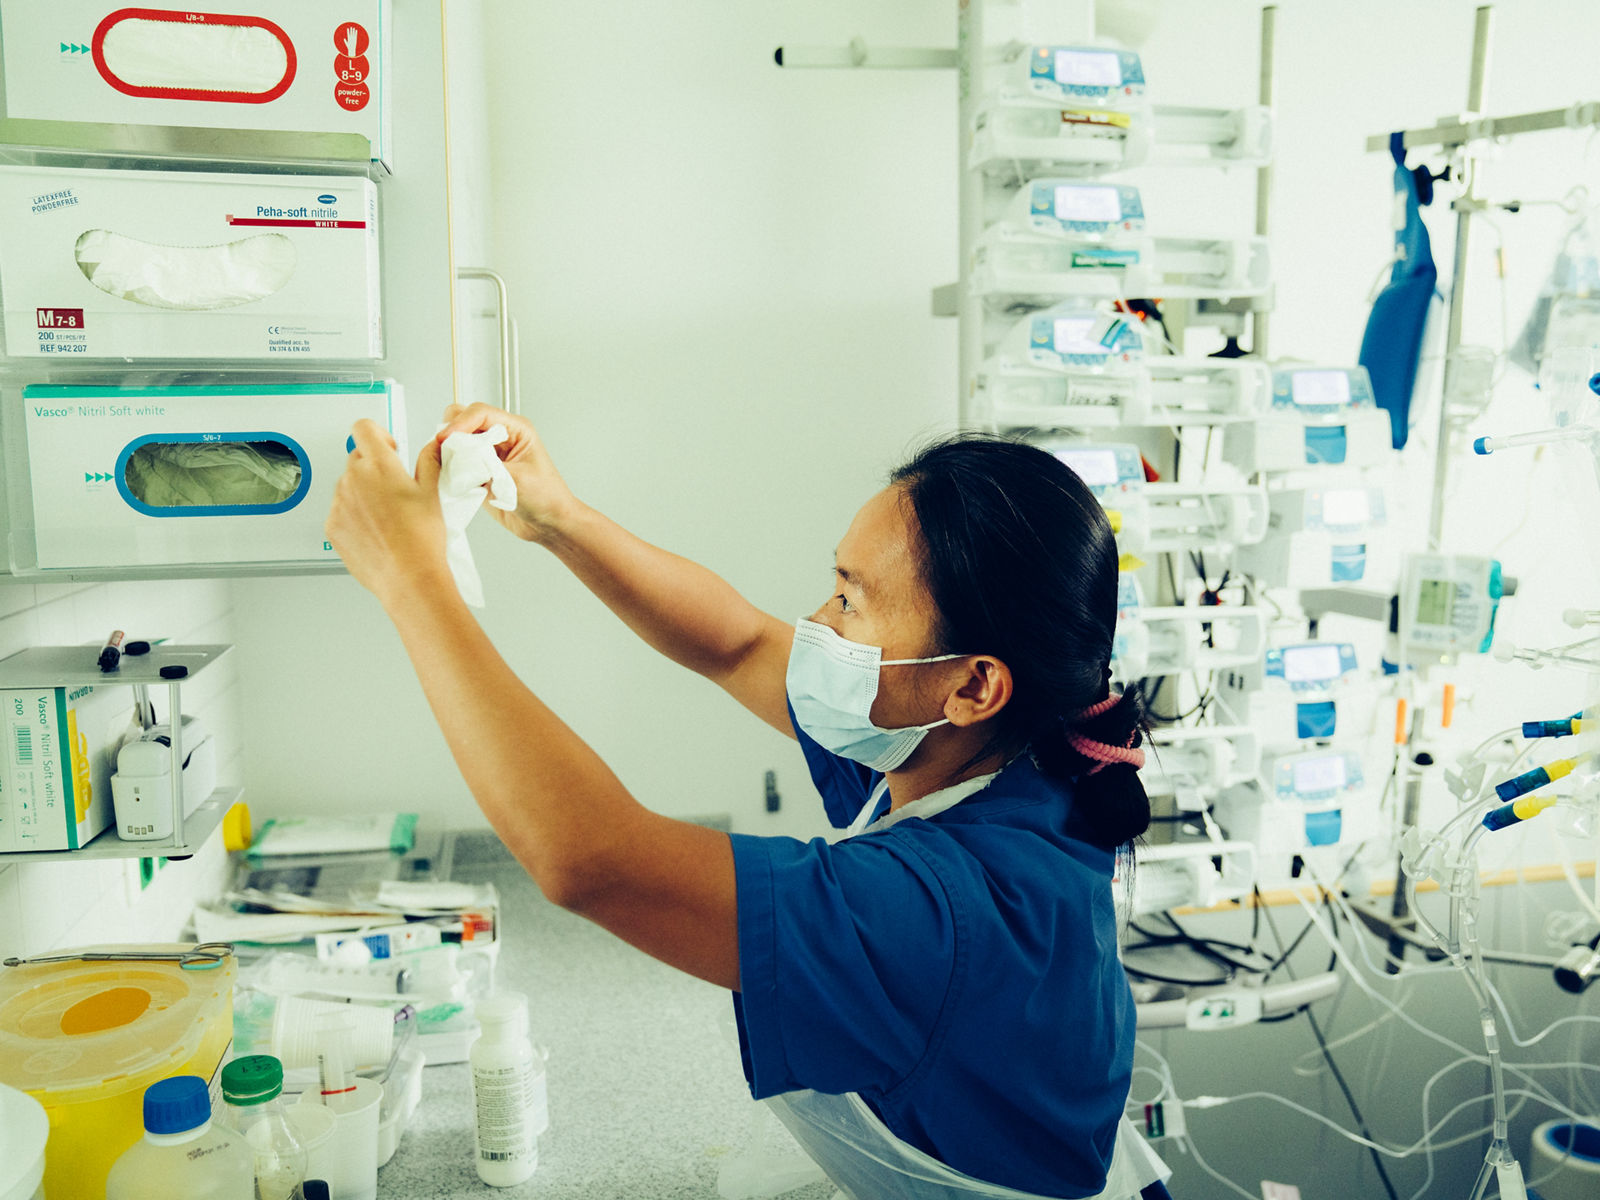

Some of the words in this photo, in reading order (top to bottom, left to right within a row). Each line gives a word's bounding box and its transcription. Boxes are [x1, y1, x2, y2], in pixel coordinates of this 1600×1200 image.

[349, 59, 356, 71] L
[341, 70, 362, 81] 8-9
[337, 88, 367, 97] powder-
[345, 97, 360, 105] free
[33, 191, 72, 204] LATEXFREE
[32, 197, 79, 212] POWDERFREE
[256, 206, 307, 218] Peha-soft
[311, 208, 338, 219] nitrile
[38, 310, 55, 327] M
[56, 316, 76, 327] 7-8
[38, 331, 55, 341] 200
[40, 344, 55, 353] REF
[78, 406, 106, 417] Nitril
[109, 406, 132, 417] Soft
[135, 405, 166, 416] white
[14, 697, 24, 716] 200
[41, 733, 51, 758] Nitril
[42, 760, 53, 781] Soft
[44, 782, 55, 809] white
